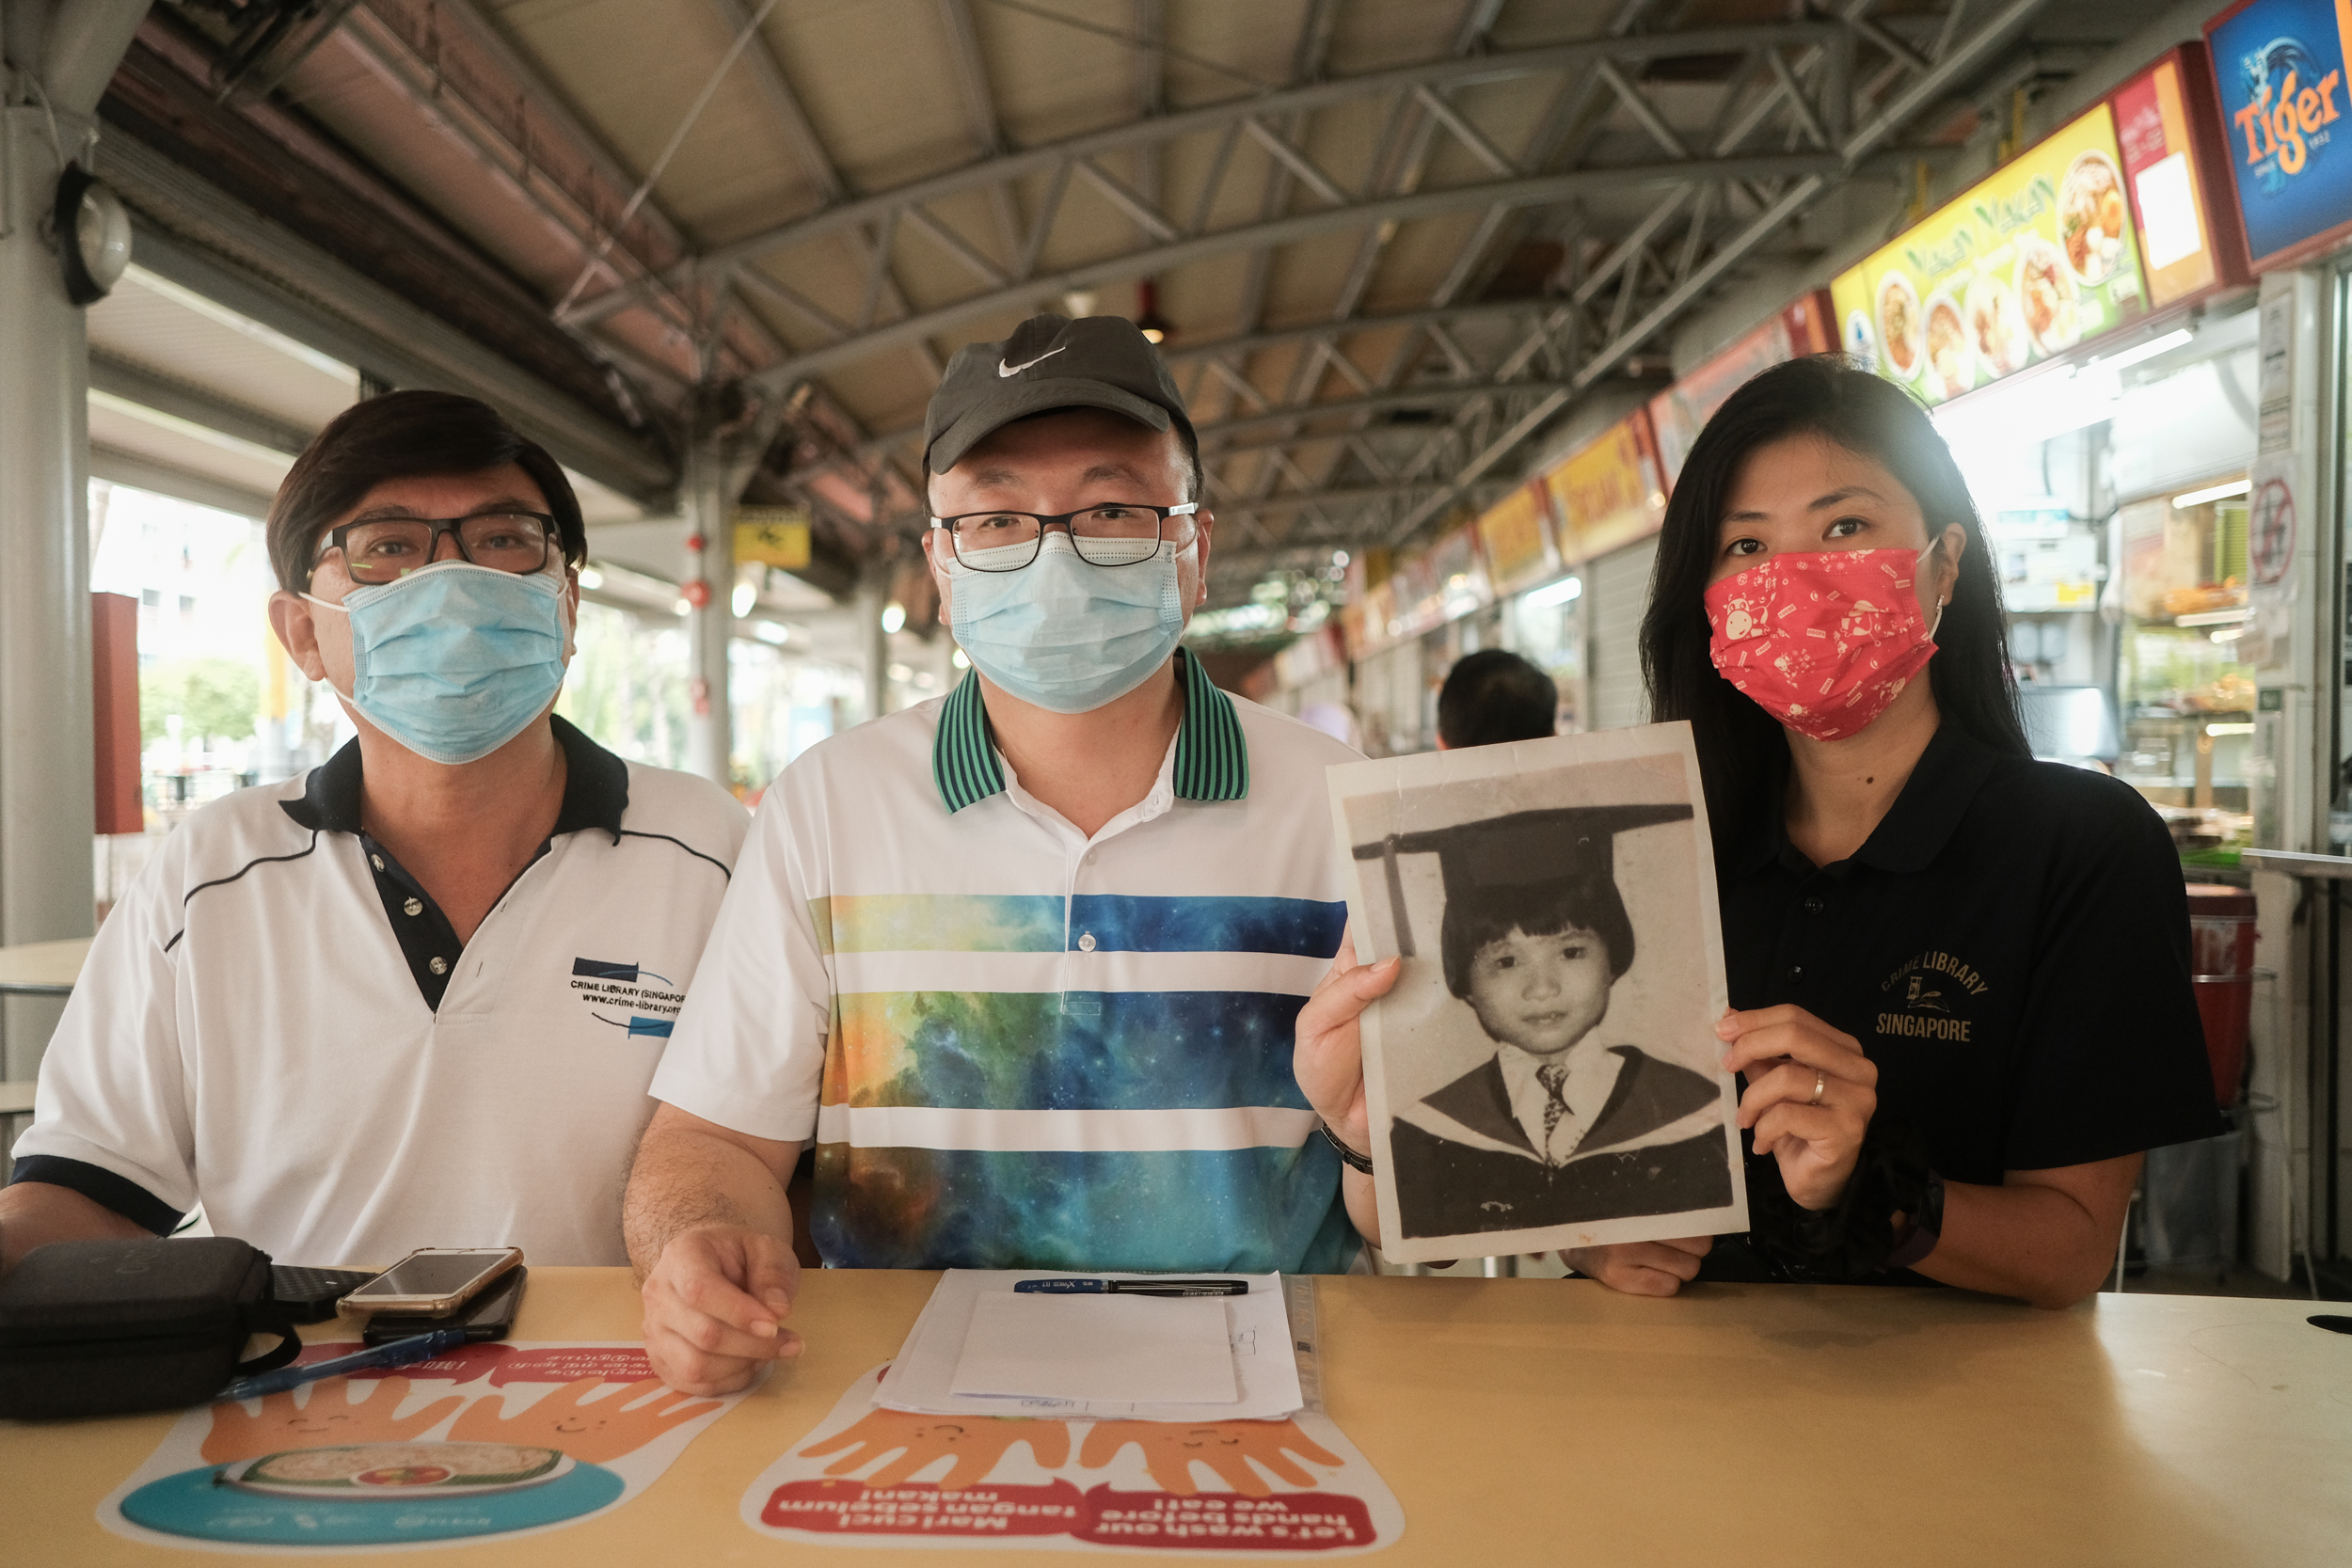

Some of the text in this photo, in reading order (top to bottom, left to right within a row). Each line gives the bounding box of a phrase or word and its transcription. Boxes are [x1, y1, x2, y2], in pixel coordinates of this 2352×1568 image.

[2234, 69, 2340, 175] Tiger
[1881, 951, 1988, 995] CRIME LIBRARY
[571, 980, 599, 991] CRIME
[602, 984, 639, 997] LIBRARY
[1876, 1013, 1971, 1042] SINGAPORE
[860, 1489, 999, 1503] makan!
[778, 1499, 1077, 1517] tangan sebelum
[1152, 1498, 1288, 1512] we eat!
[838, 1513, 1009, 1529] Mari cuci
[1100, 1510, 1347, 1527] hands before
[1094, 1522, 1355, 1541] Let's wash our
